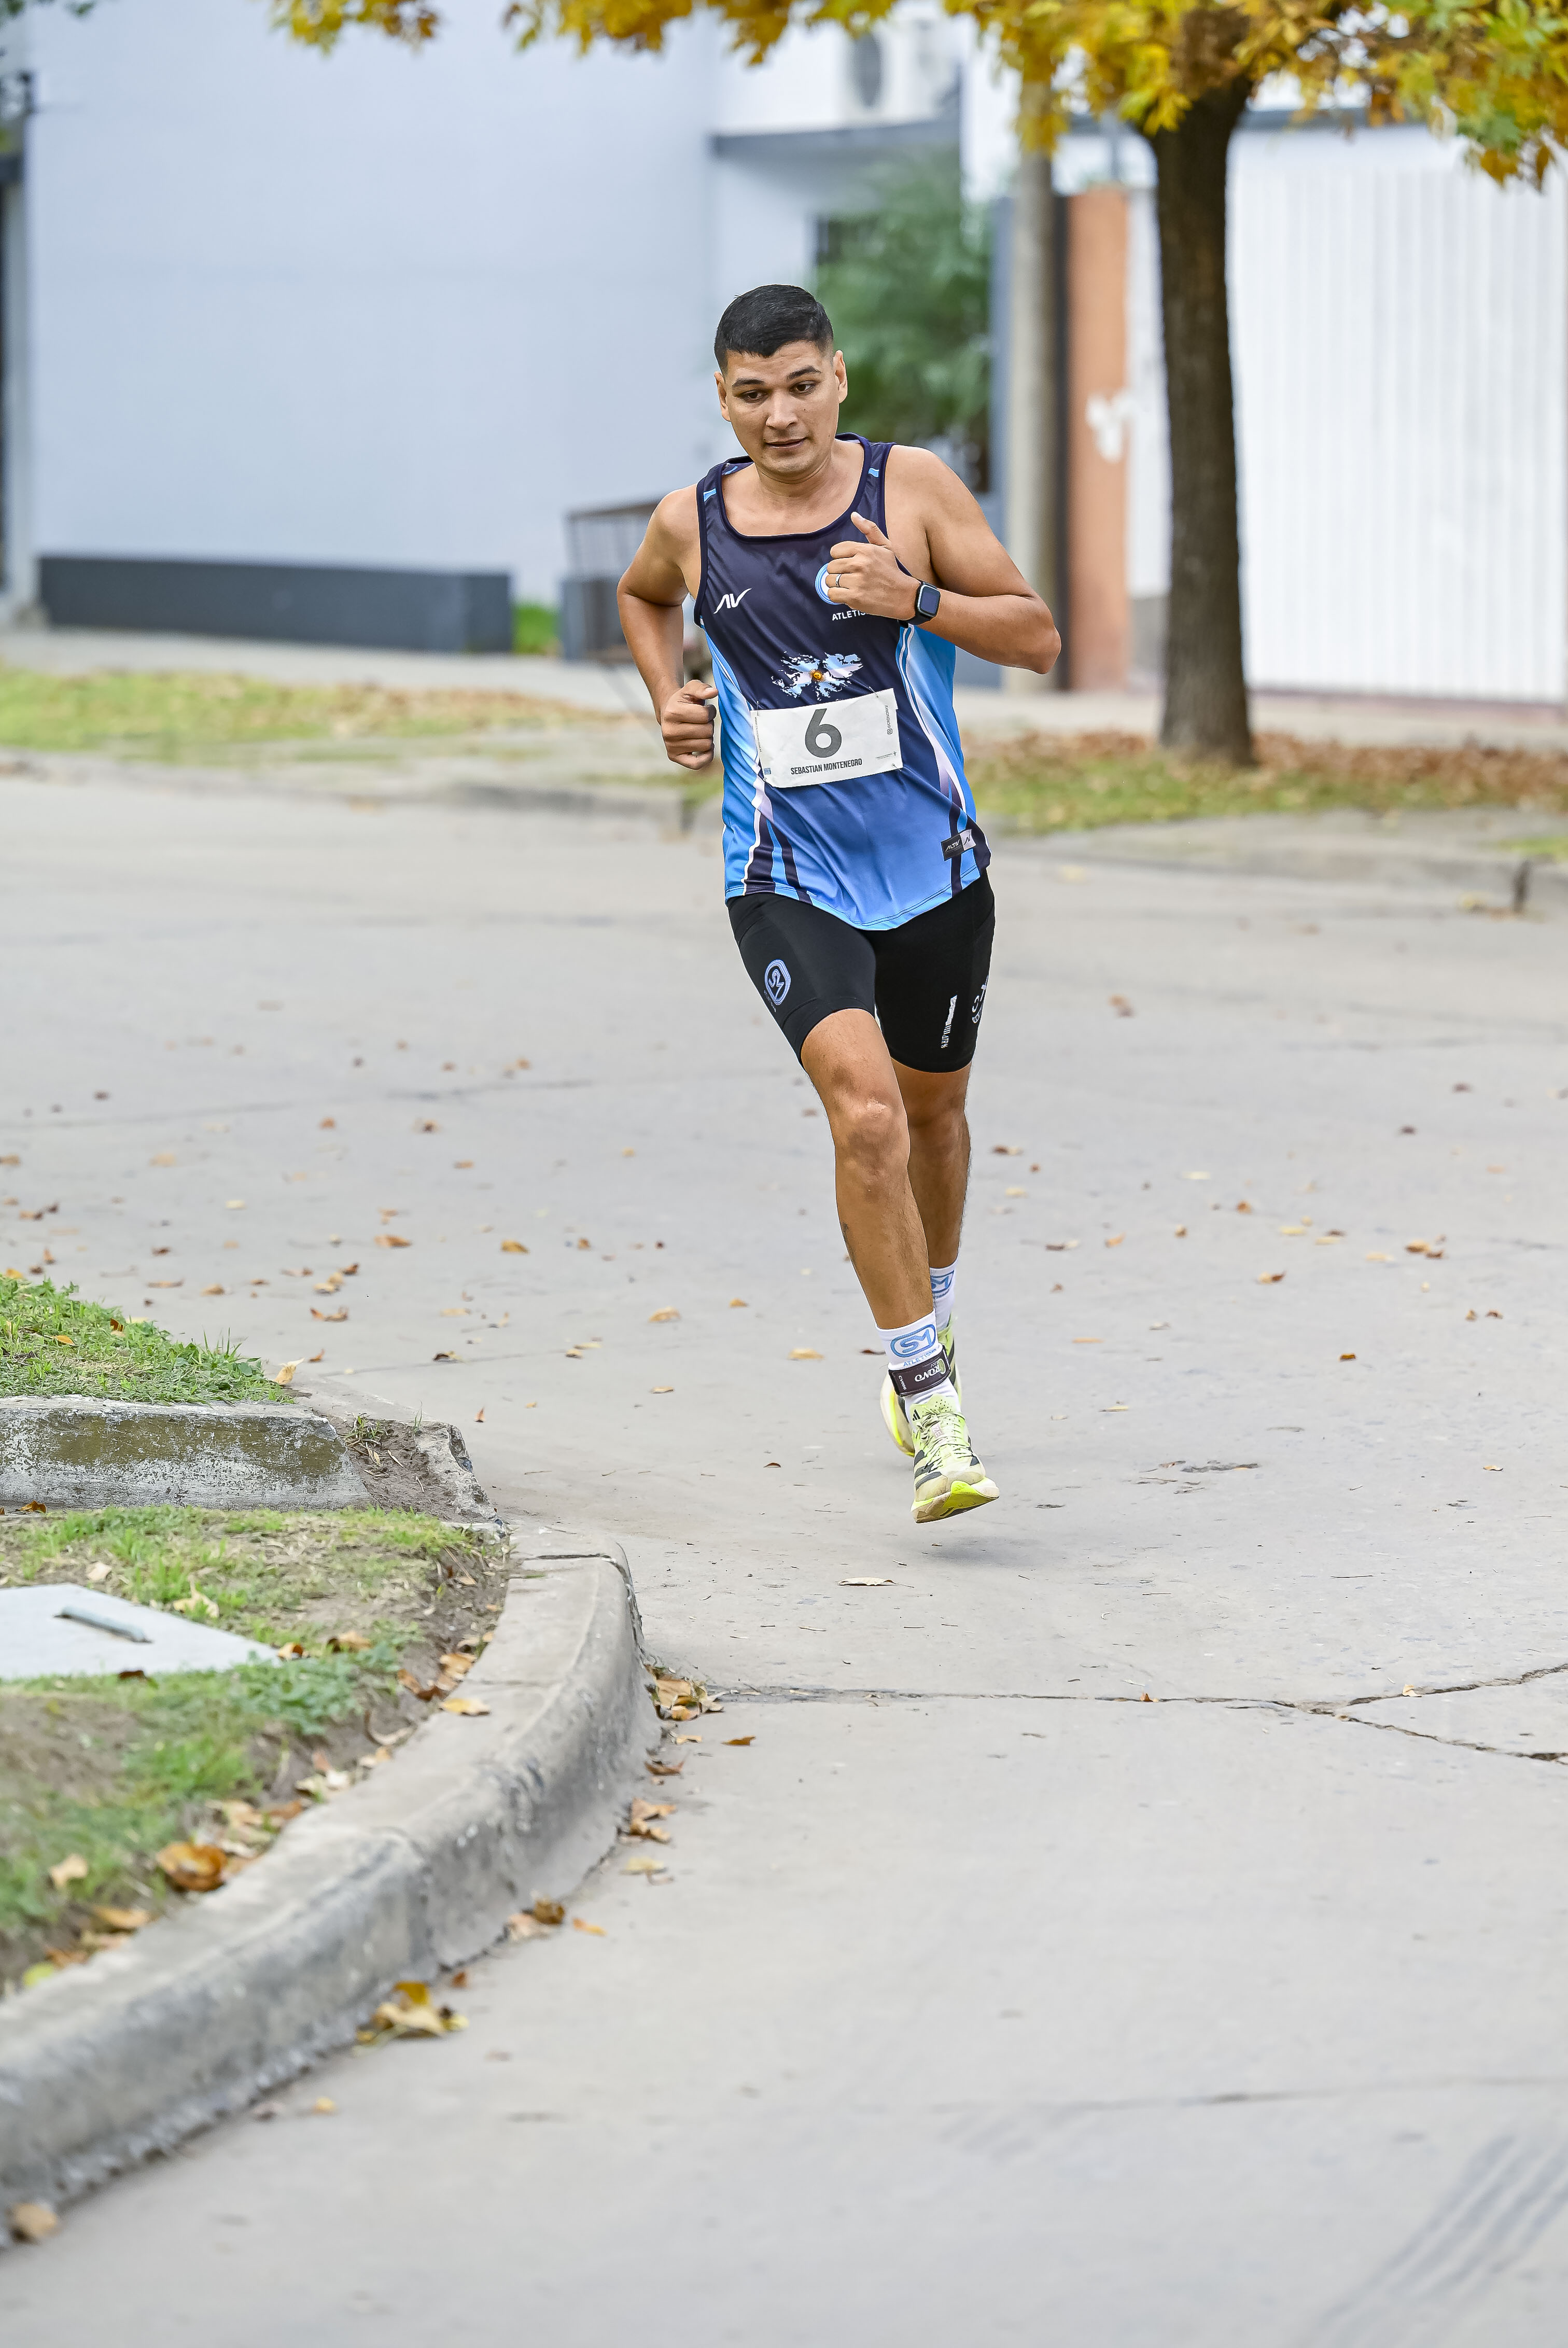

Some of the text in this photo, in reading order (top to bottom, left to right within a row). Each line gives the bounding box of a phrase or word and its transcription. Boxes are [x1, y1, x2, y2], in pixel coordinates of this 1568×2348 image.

[804, 708, 842, 758] 6
[790, 758, 862, 775] SEBASTIAN MONTENEGRO
